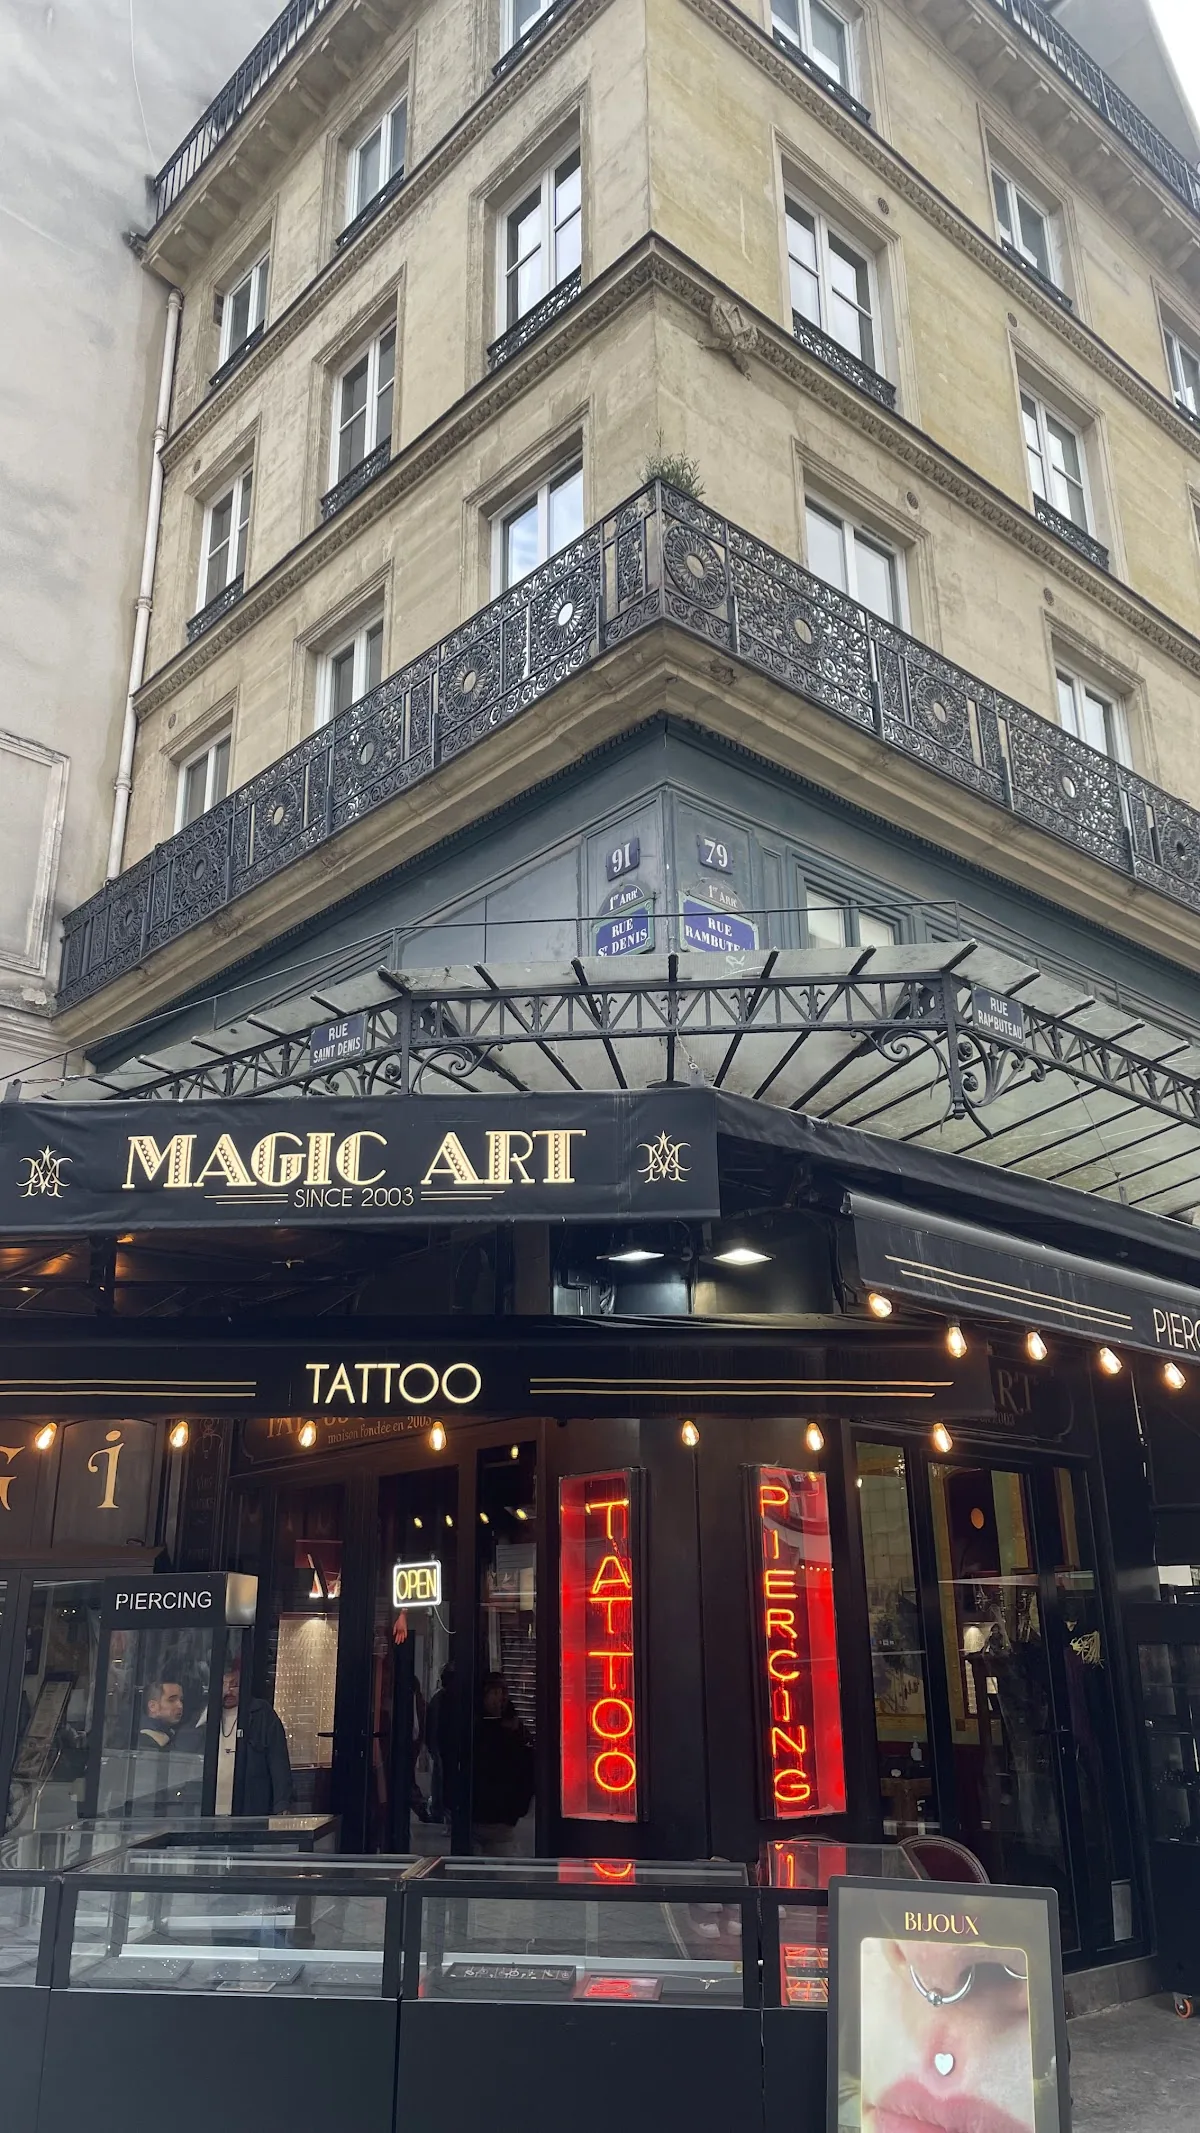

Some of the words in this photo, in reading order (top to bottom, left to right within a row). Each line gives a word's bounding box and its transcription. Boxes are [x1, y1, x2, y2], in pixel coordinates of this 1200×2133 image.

[611, 842, 632, 873] 91
[704, 838, 728, 868] 79
[612, 918, 633, 938] RUE
[685, 925, 746, 952] RAMBUTE
[707, 917, 733, 937] RUE
[611, 928, 647, 954] DENIS
[989, 996, 1009, 1017] RUE
[328, 1023, 348, 1042] RUE
[978, 1009, 1022, 1040] RAMBUTEAU
[313, 1044, 336, 1063] SAINT
[337, 1036, 361, 1056] DENIS
[121, 1131, 388, 1189] MAGIC
[421, 1129, 587, 1185] ART
[293, 1187, 353, 1208] SINCE
[361, 1187, 414, 1207] 2003
[305, 1362, 482, 1404] TATTOO
[327, 1429, 359, 1445] maison
[360, 1421, 392, 1437] fondée
[392, 1421, 405, 1432] en
[396, 1568, 438, 1600] OPEN
[115, 1591, 213, 1611] PIERCING
[588, 1499, 637, 1791] TATTOO
[760, 1485, 811, 1802] PIERCING
[904, 1911, 980, 1936] BIJOUX
